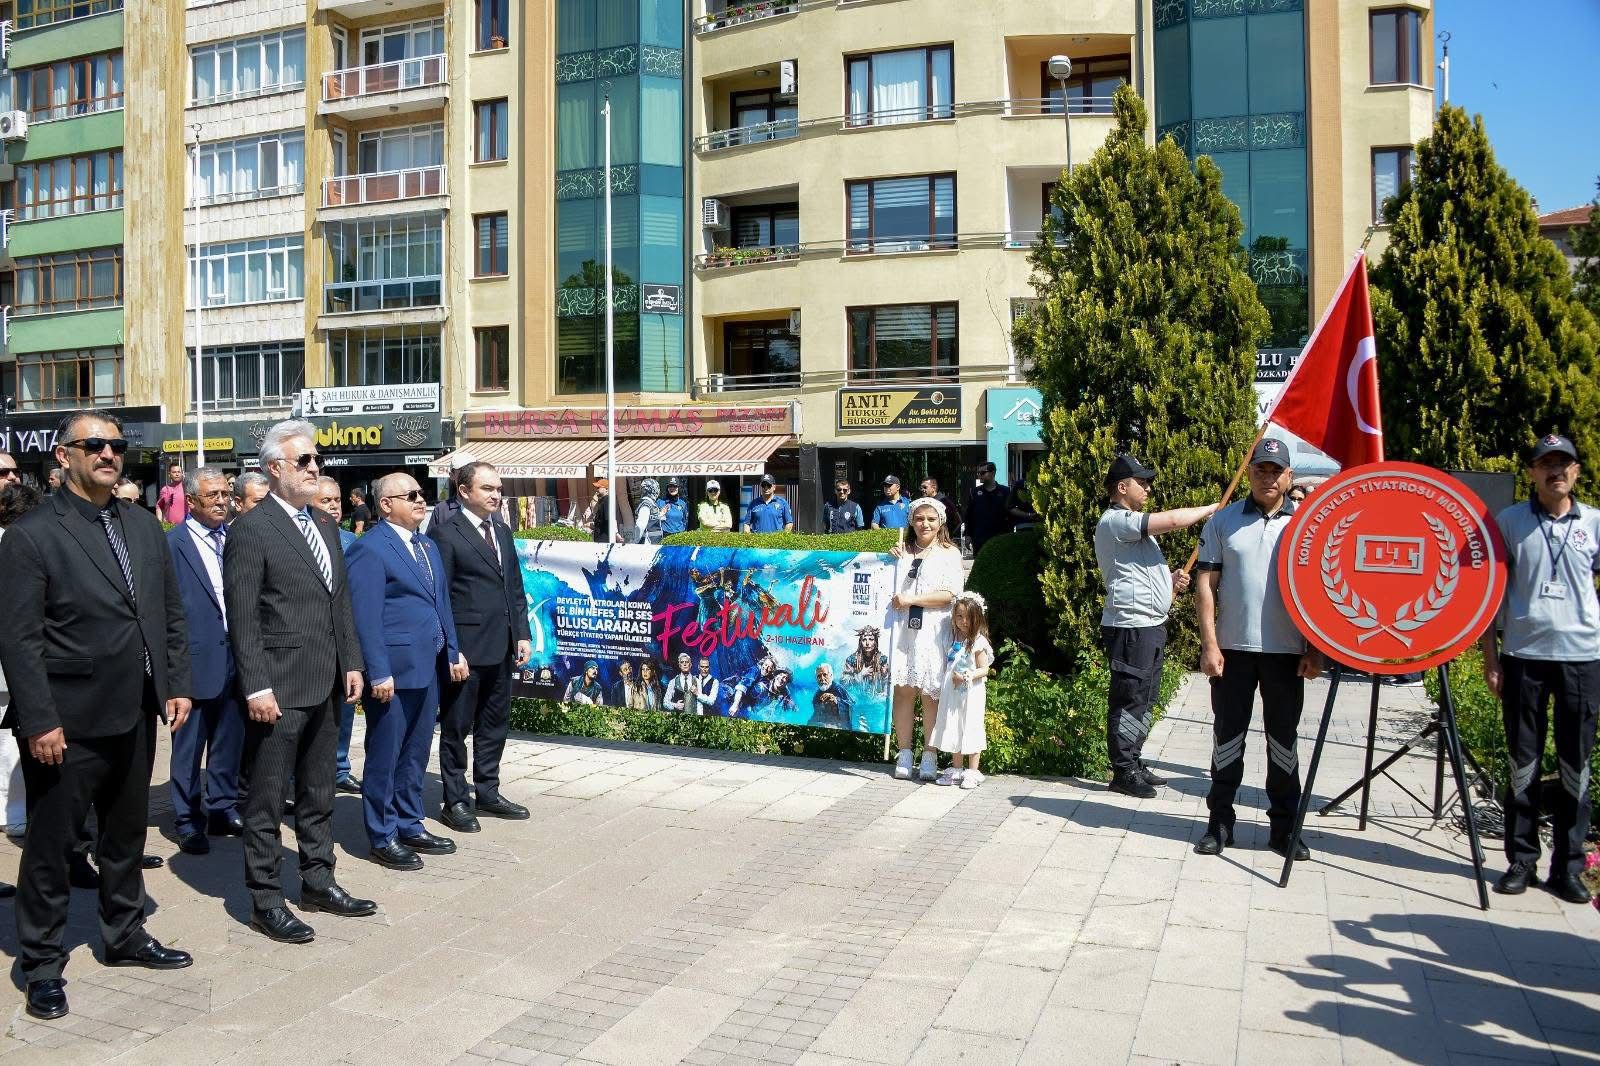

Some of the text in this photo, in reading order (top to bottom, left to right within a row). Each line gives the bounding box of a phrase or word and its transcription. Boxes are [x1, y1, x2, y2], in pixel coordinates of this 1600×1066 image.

[340, 389, 368, 400] HUKUK
[845, 394, 891, 409] ANIT
[909, 408, 920, 416] Av.
[484, 407, 704, 438] BURSA KUMAŞ
[847, 416, 888, 425] BÜROSU
[897, 417, 907, 425] Av.
[495, 466, 577, 477] MAŞ PAZARI
[706, 464, 758, 473] PAZARI
[1298, 480, 1484, 570] KONYA DEVLET TİYATROSU MÜDÜRLÜĞÜ
[556, 597, 582, 605] DEVLET
[628, 601, 652, 610] KONYA
[556, 605, 653, 620] 18. BİN NEFES, BİR SES
[652, 576, 830, 662] Festivali
[556, 615, 652, 635] ULUSLARARASI
[556, 629, 652, 643] TÜRKÇE TİYATRO YAPAN ÜLKELER
[766, 634, 825, 647] 2-10 HAZİRAN
